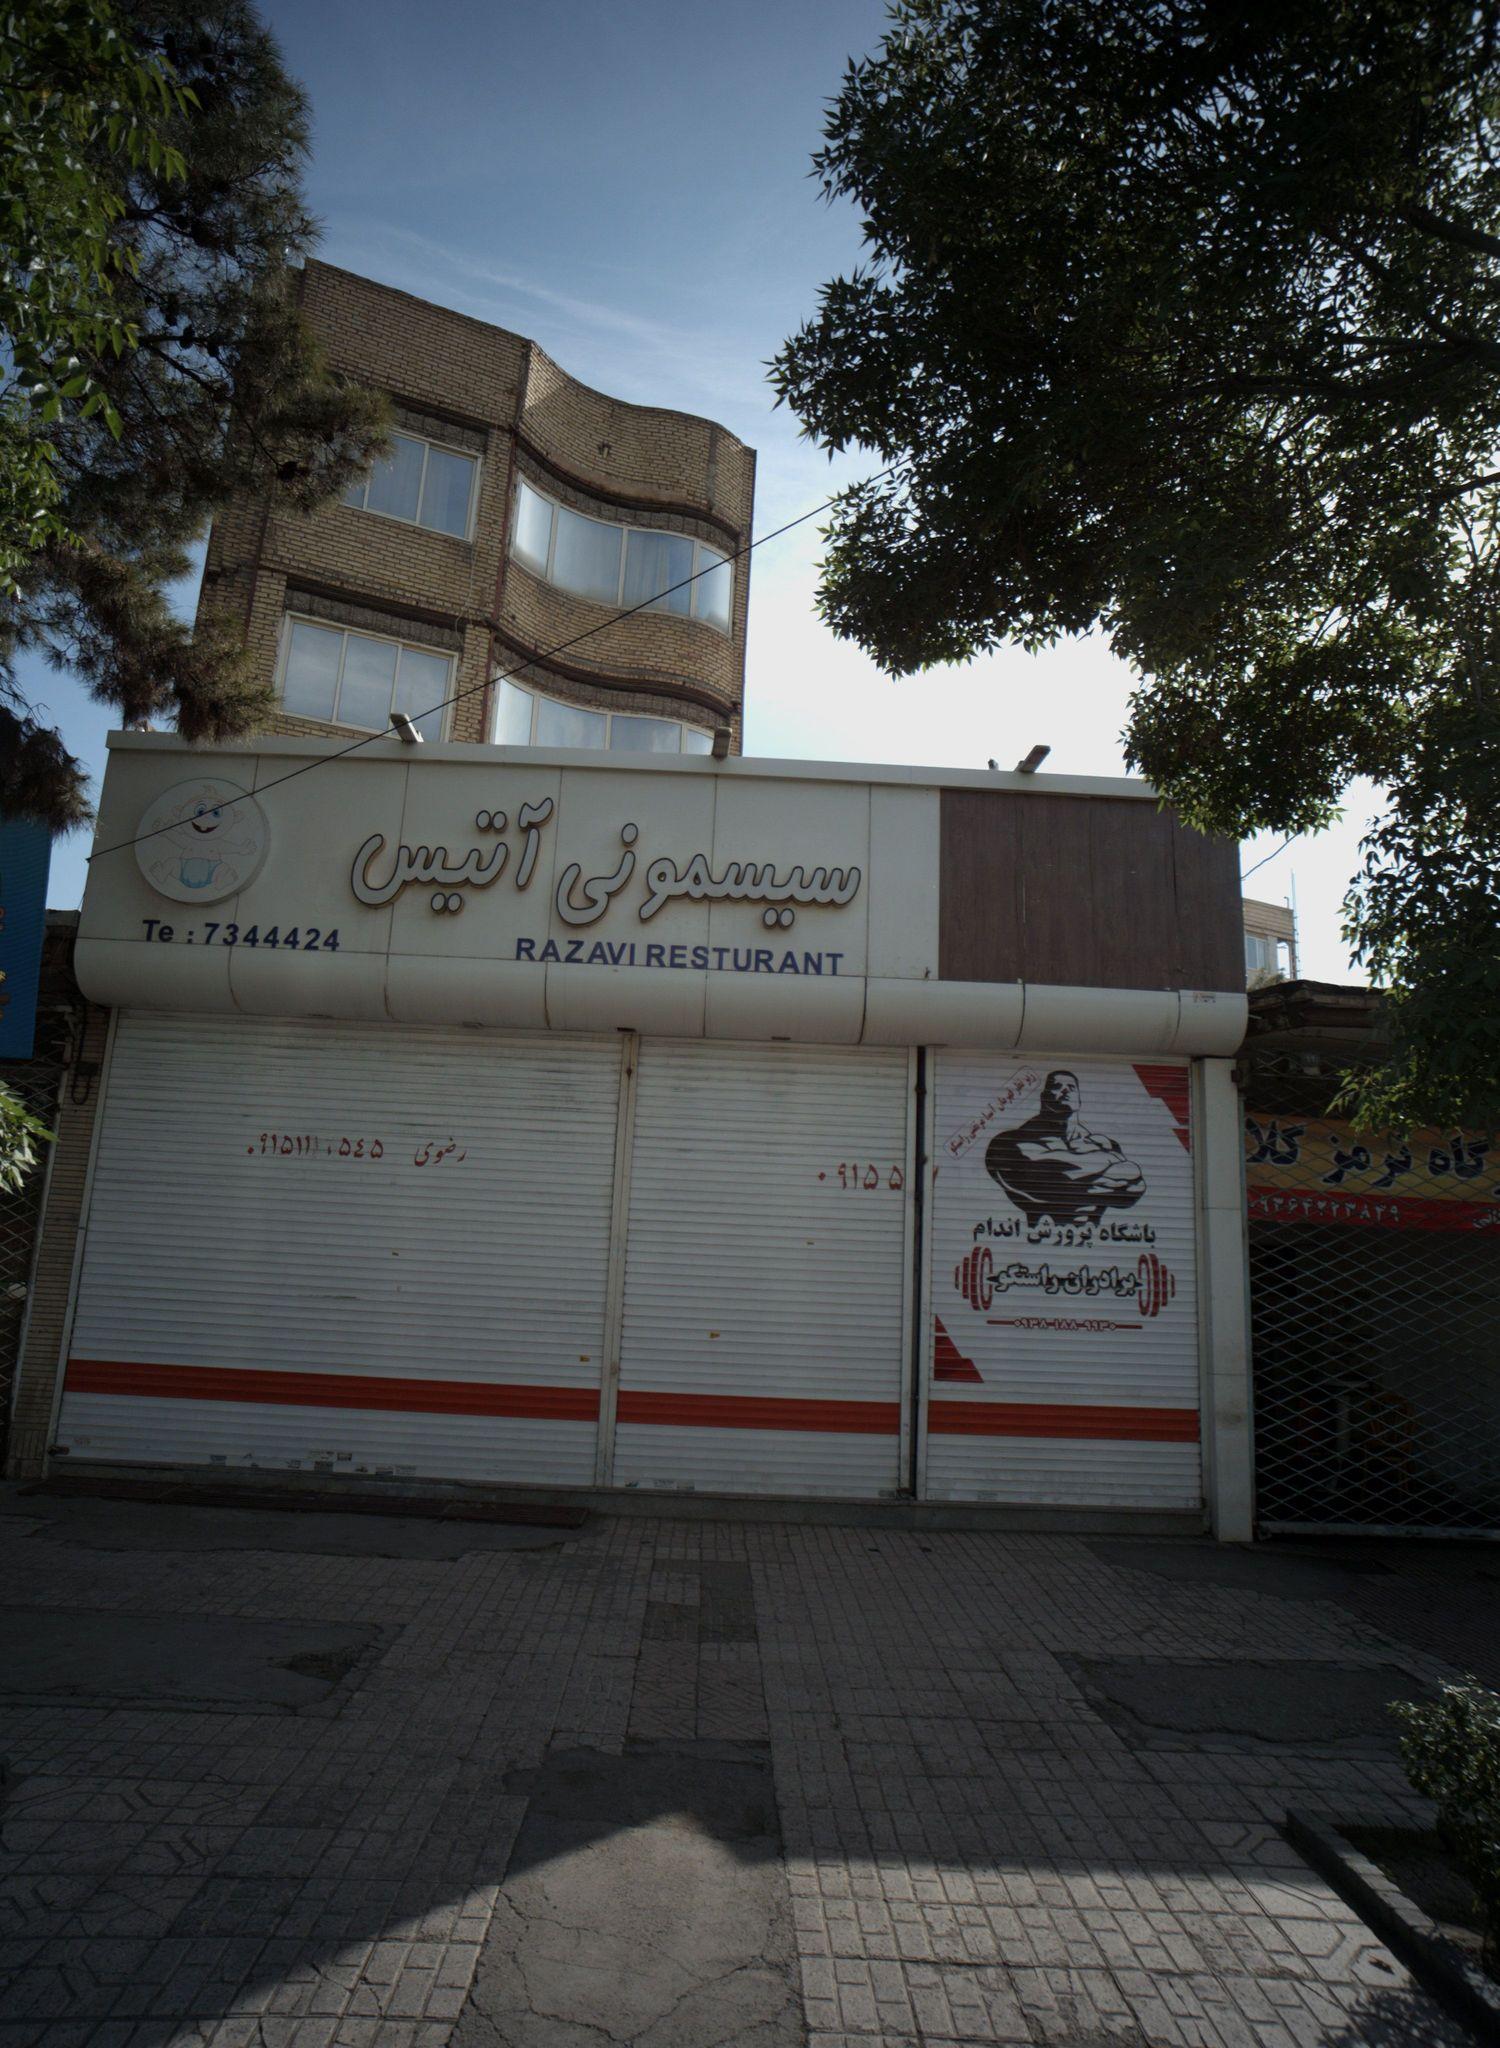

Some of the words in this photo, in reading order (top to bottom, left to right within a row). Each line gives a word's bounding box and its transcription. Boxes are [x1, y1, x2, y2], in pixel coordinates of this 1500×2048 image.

[556, 822, 861, 929] سیسمونی
[515, 938, 636, 966] RAZAVI
[646, 944, 844, 976] RESTURANT
[973, 1217, 1020, 1241] اندام
[1027, 1218, 1094, 1248] پرورش
[1100, 1221, 1157, 1248] باشگاه
[1063, 1265, 1137, 1296] برادران
